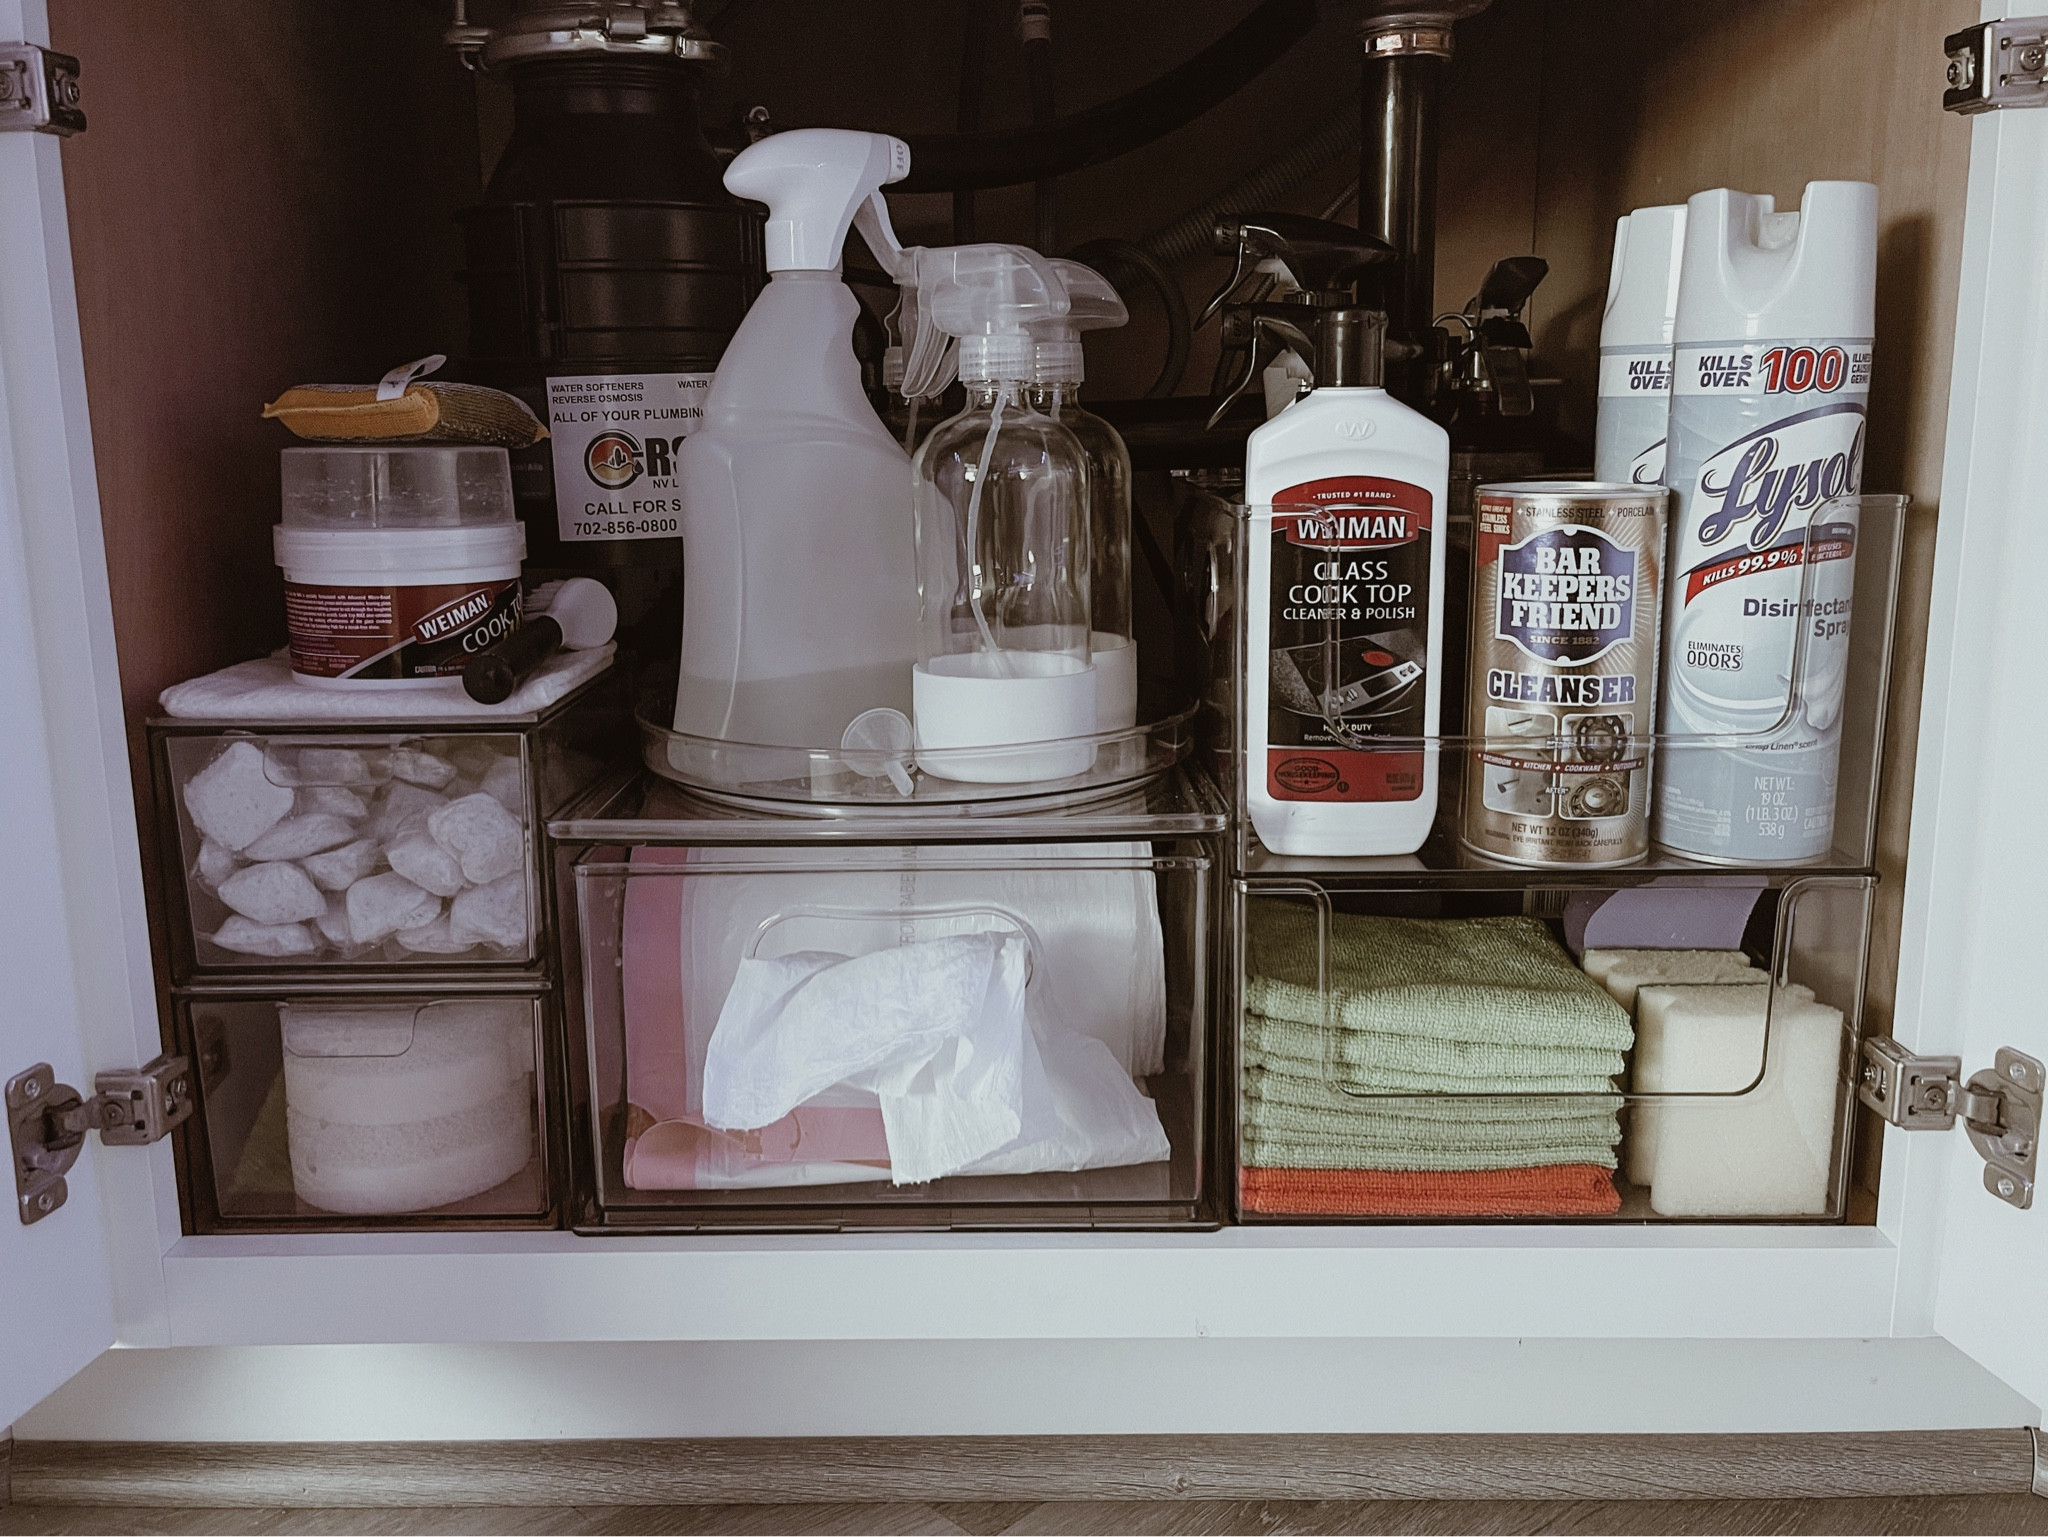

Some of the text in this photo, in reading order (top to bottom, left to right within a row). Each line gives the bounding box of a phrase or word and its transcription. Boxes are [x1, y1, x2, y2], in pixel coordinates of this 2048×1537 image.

[1699, 355, 1753, 372] KILLS
[1759, 346, 1849, 394] 100
[551, 382, 644, 393] WATER SOFTENERS
[678, 381, 708, 389] WATER
[1700, 372, 1752, 388] OVER
[552, 394, 643, 404] REVERSE OSMOSIS
[553, 408, 704, 423] ALL OF YOUR PLUMBIN
[653, 479, 669, 488] NV
[1698, 420, 1864, 548] Lysol
[584, 502, 628, 516] CALL
[634, 500, 666, 513] FOR
[1526, 508, 1574, 518] STAINLESS
[1577, 508, 1606, 518] STEEL
[574, 519, 677, 535] 702-856-0800
[1535, 547, 1601, 574] BAR
[1703, 565, 1735, 586] KILLS
[1738, 550, 1797, 574] 99.9%
[1366, 584, 1412, 603] TOP
[1503, 572, 1631, 602] KEEPERS
[418, 594, 488, 639] WEIMAN
[1351, 608, 1361, 620] &
[1366, 607, 1415, 620] POLISH
[1510, 600, 1622, 630] FRIEND
[462, 609, 511, 652] COOK
[1530, 636, 1600, 646] SINCE 1882
[1688, 640, 1742, 653] ELIMINATES
[1687, 650, 1742, 669] ODORS
[1488, 670, 1635, 705] CLEANSER
[1523, 761, 1552, 770] KITCHEN
[1613, 761, 1637, 770] OUTDOOR
[1754, 776, 1774, 790] NET
[1761, 792, 1770, 806] 19
[1772, 807, 1780, 820] 3
[1512, 822, 1598, 838] NET WT 12 OZ (340g)
[1758, 822, 1784, 840] 538 g
